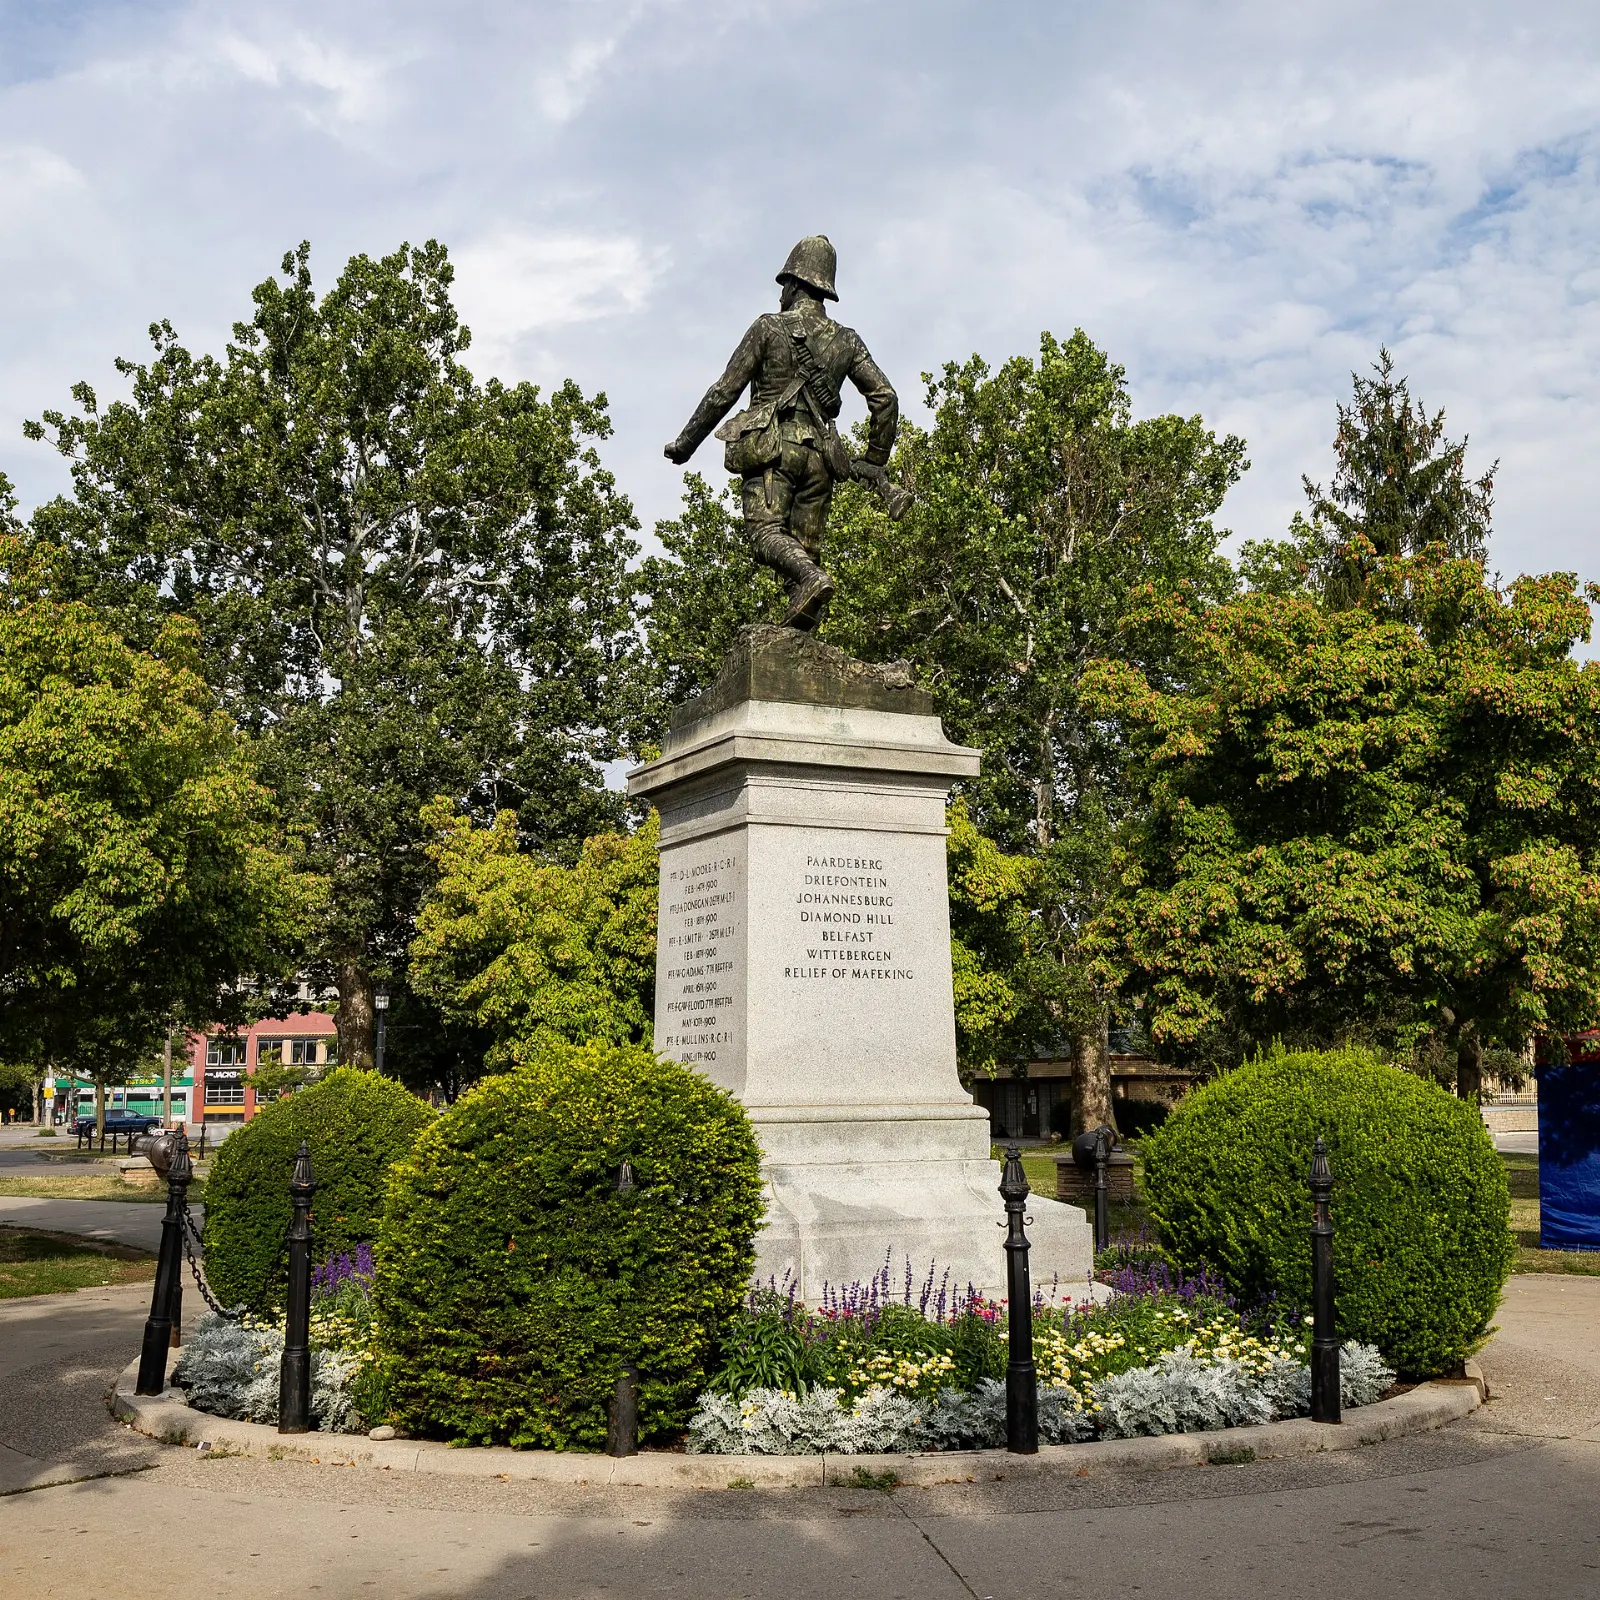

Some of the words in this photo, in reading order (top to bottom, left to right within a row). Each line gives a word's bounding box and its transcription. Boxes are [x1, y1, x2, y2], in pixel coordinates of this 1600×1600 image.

[807, 856, 883, 870] PAARDEBERG
[804, 874, 887, 888] DRIEFONTEIN
[796, 893, 893, 907] JOHANNESBURG
[800, 911, 861, 924] DIAMOND
[866, 914, 894, 925] HILL
[822, 931, 874, 942] BELFAST
[806, 948, 891, 961] WITTEBERGEN
[784, 967, 827, 978] RELIEF
[831, 968, 847, 979] OF
[851, 968, 914, 980] MAFEKING
